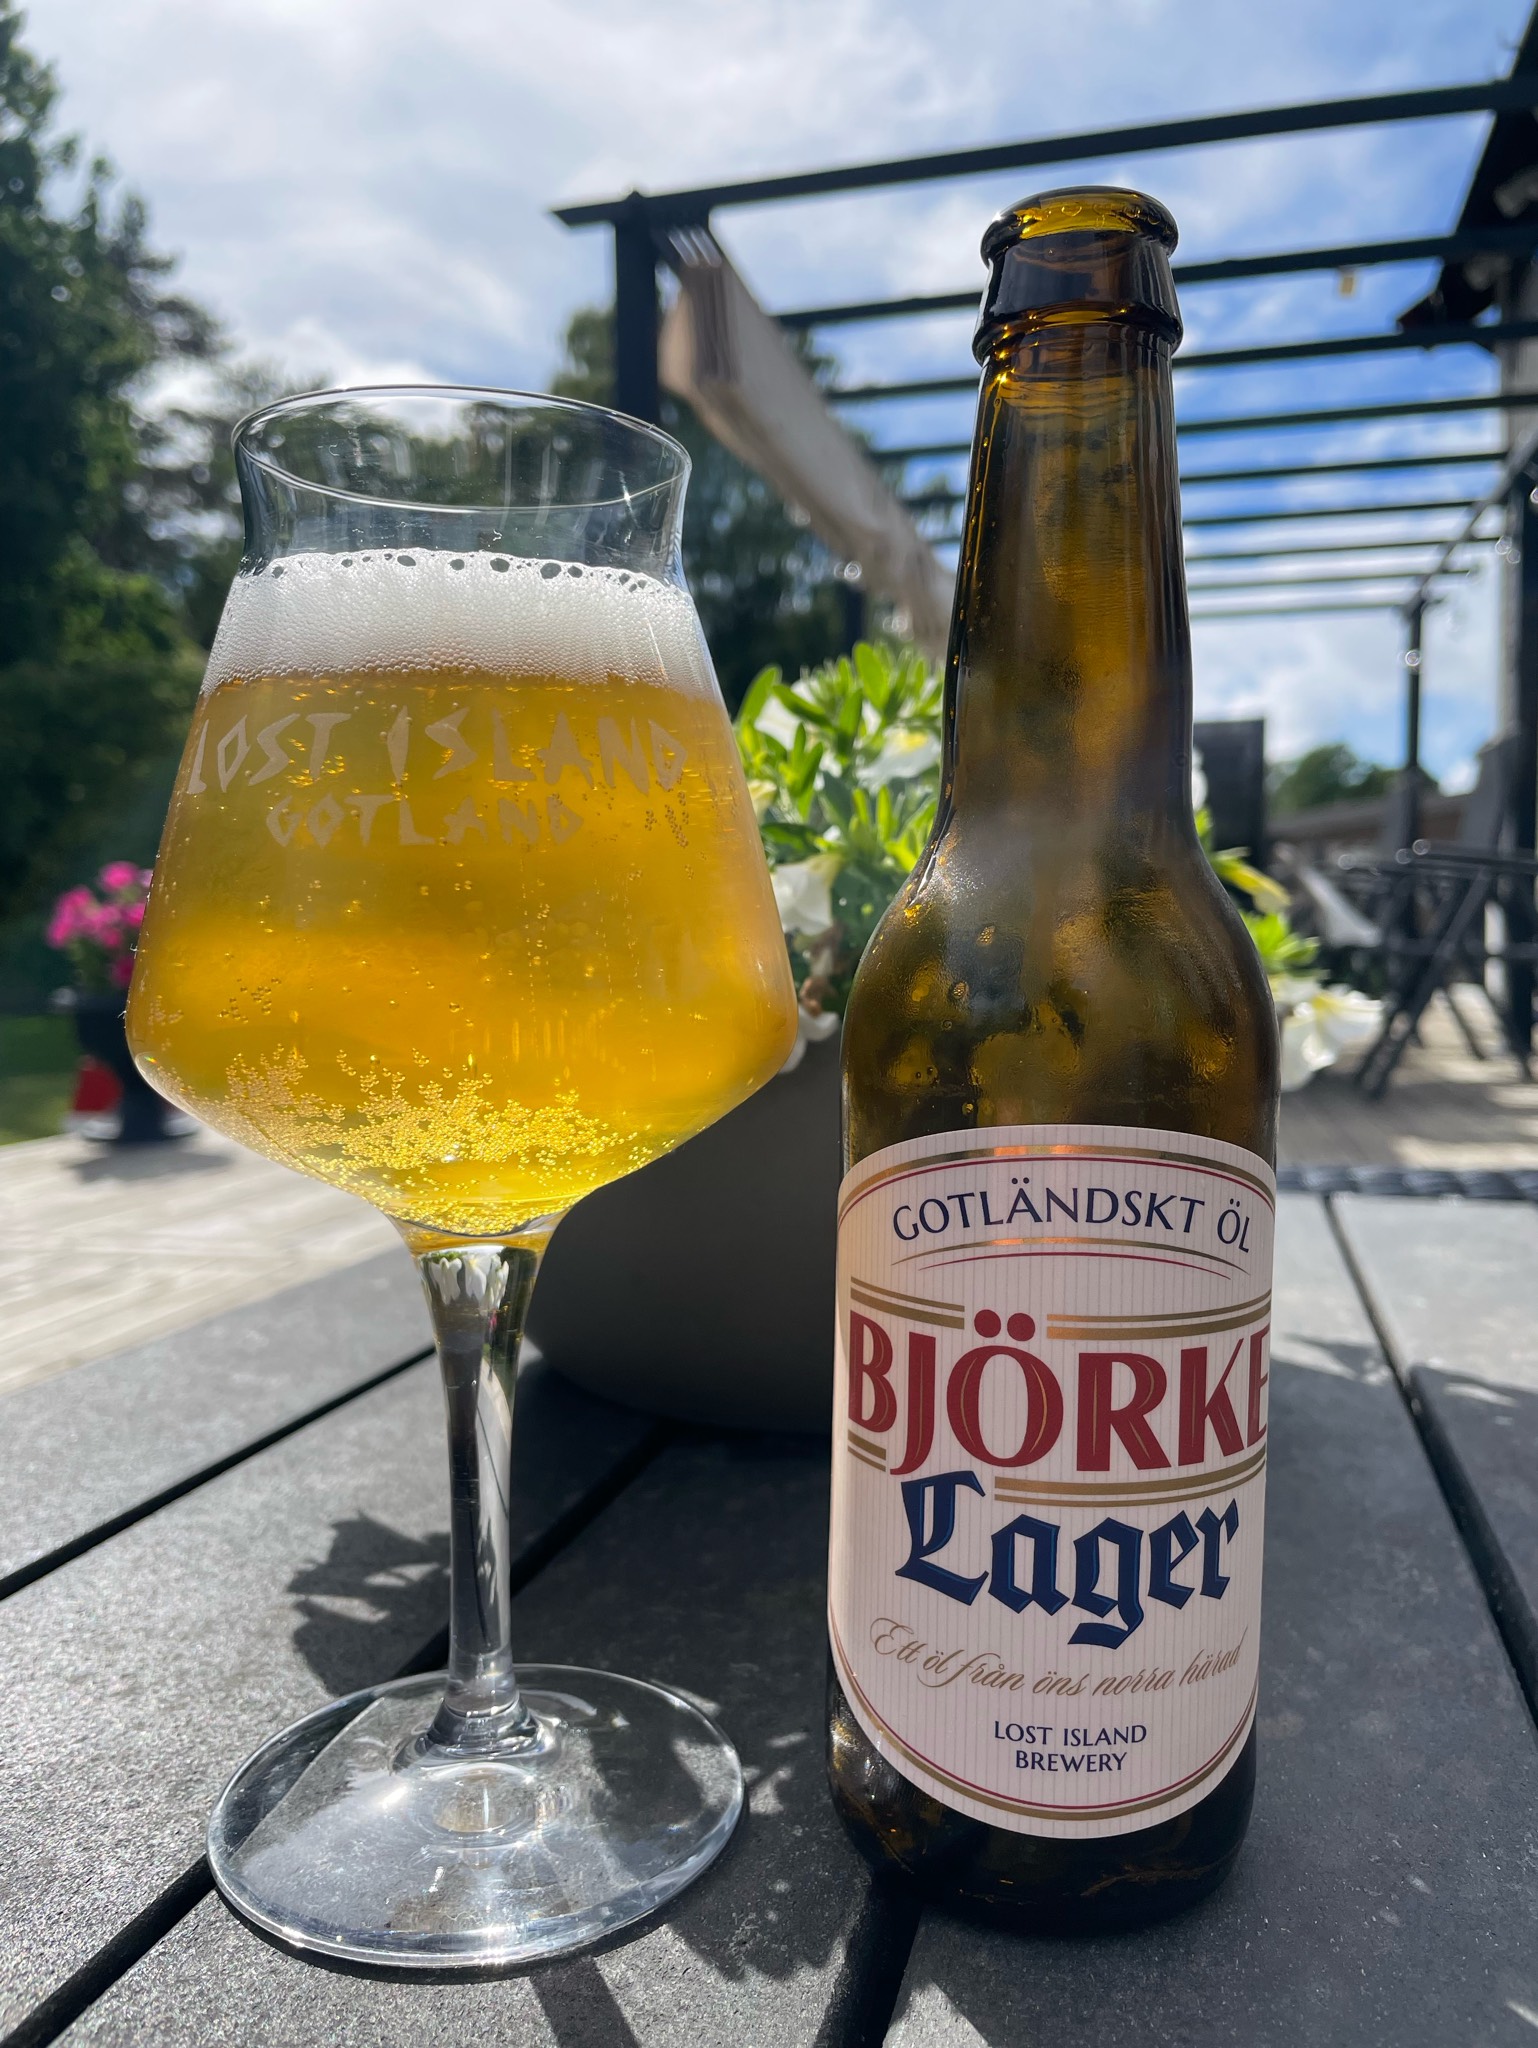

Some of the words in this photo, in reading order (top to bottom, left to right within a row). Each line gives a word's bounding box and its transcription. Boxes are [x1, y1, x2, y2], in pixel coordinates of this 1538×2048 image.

[186, 712, 352, 794] LOST
[387, 705, 688, 795] ISLAND
[265, 794, 585, 849] GOTLAND
[892, 1176, 1206, 1241] GOTLÄNDSKT
[1216, 1198, 1251, 1254] ÖL
[848, 1309, 1271, 1475] BJÖRKE
[894, 1470, 1241, 1651] Lager
[869, 1617, 928, 1664] Ett
[922, 1649, 965, 1675] öl
[916, 1652, 1026, 1691] från
[1031, 1670, 1088, 1697] öns
[1091, 1668, 1176, 1697] norra
[993, 1720, 1054, 1746] LOST
[1063, 1723, 1148, 1748] ISLAND
[1014, 1750, 1128, 1774] BREWERY
